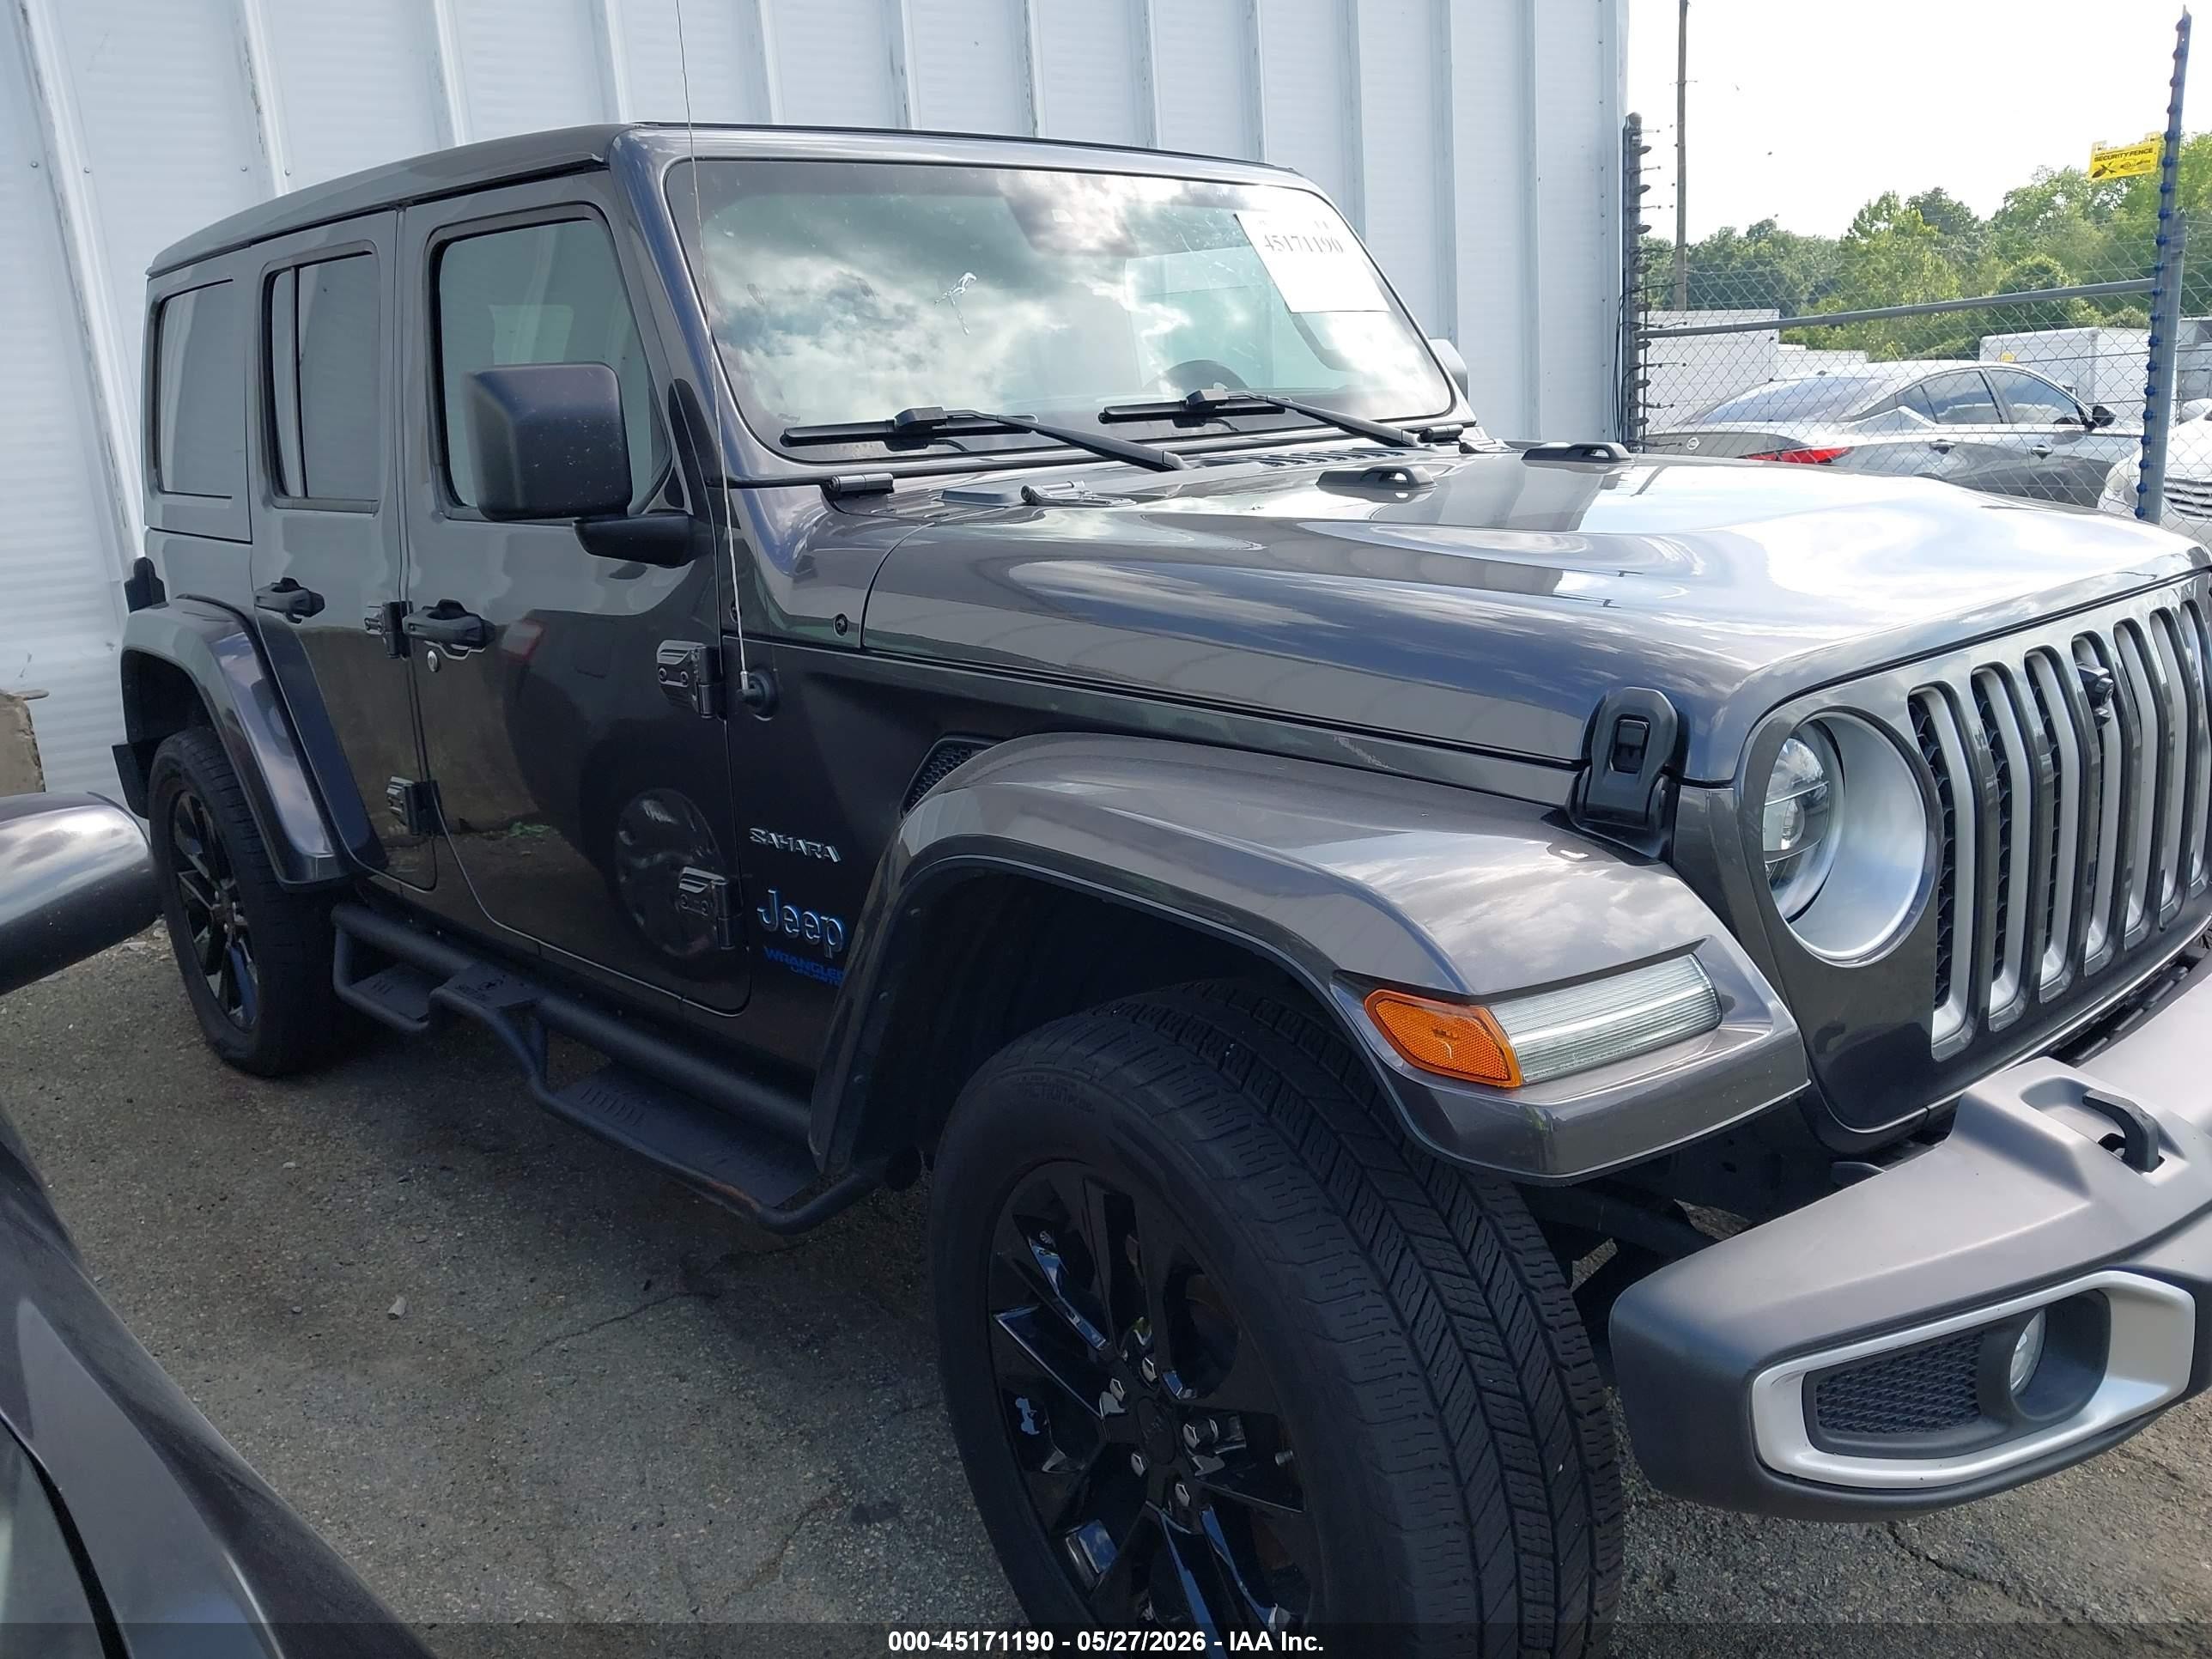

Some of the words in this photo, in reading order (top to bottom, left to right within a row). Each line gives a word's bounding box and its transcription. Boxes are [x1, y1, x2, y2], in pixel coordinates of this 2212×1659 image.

[2094, 151, 2129, 162] SECURITY
[2129, 148, 2154, 157] FENCE
[1264, 234, 1344, 254] 45171190
[749, 827, 842, 863] SAHARA
[756, 888, 845, 960] Jeep
